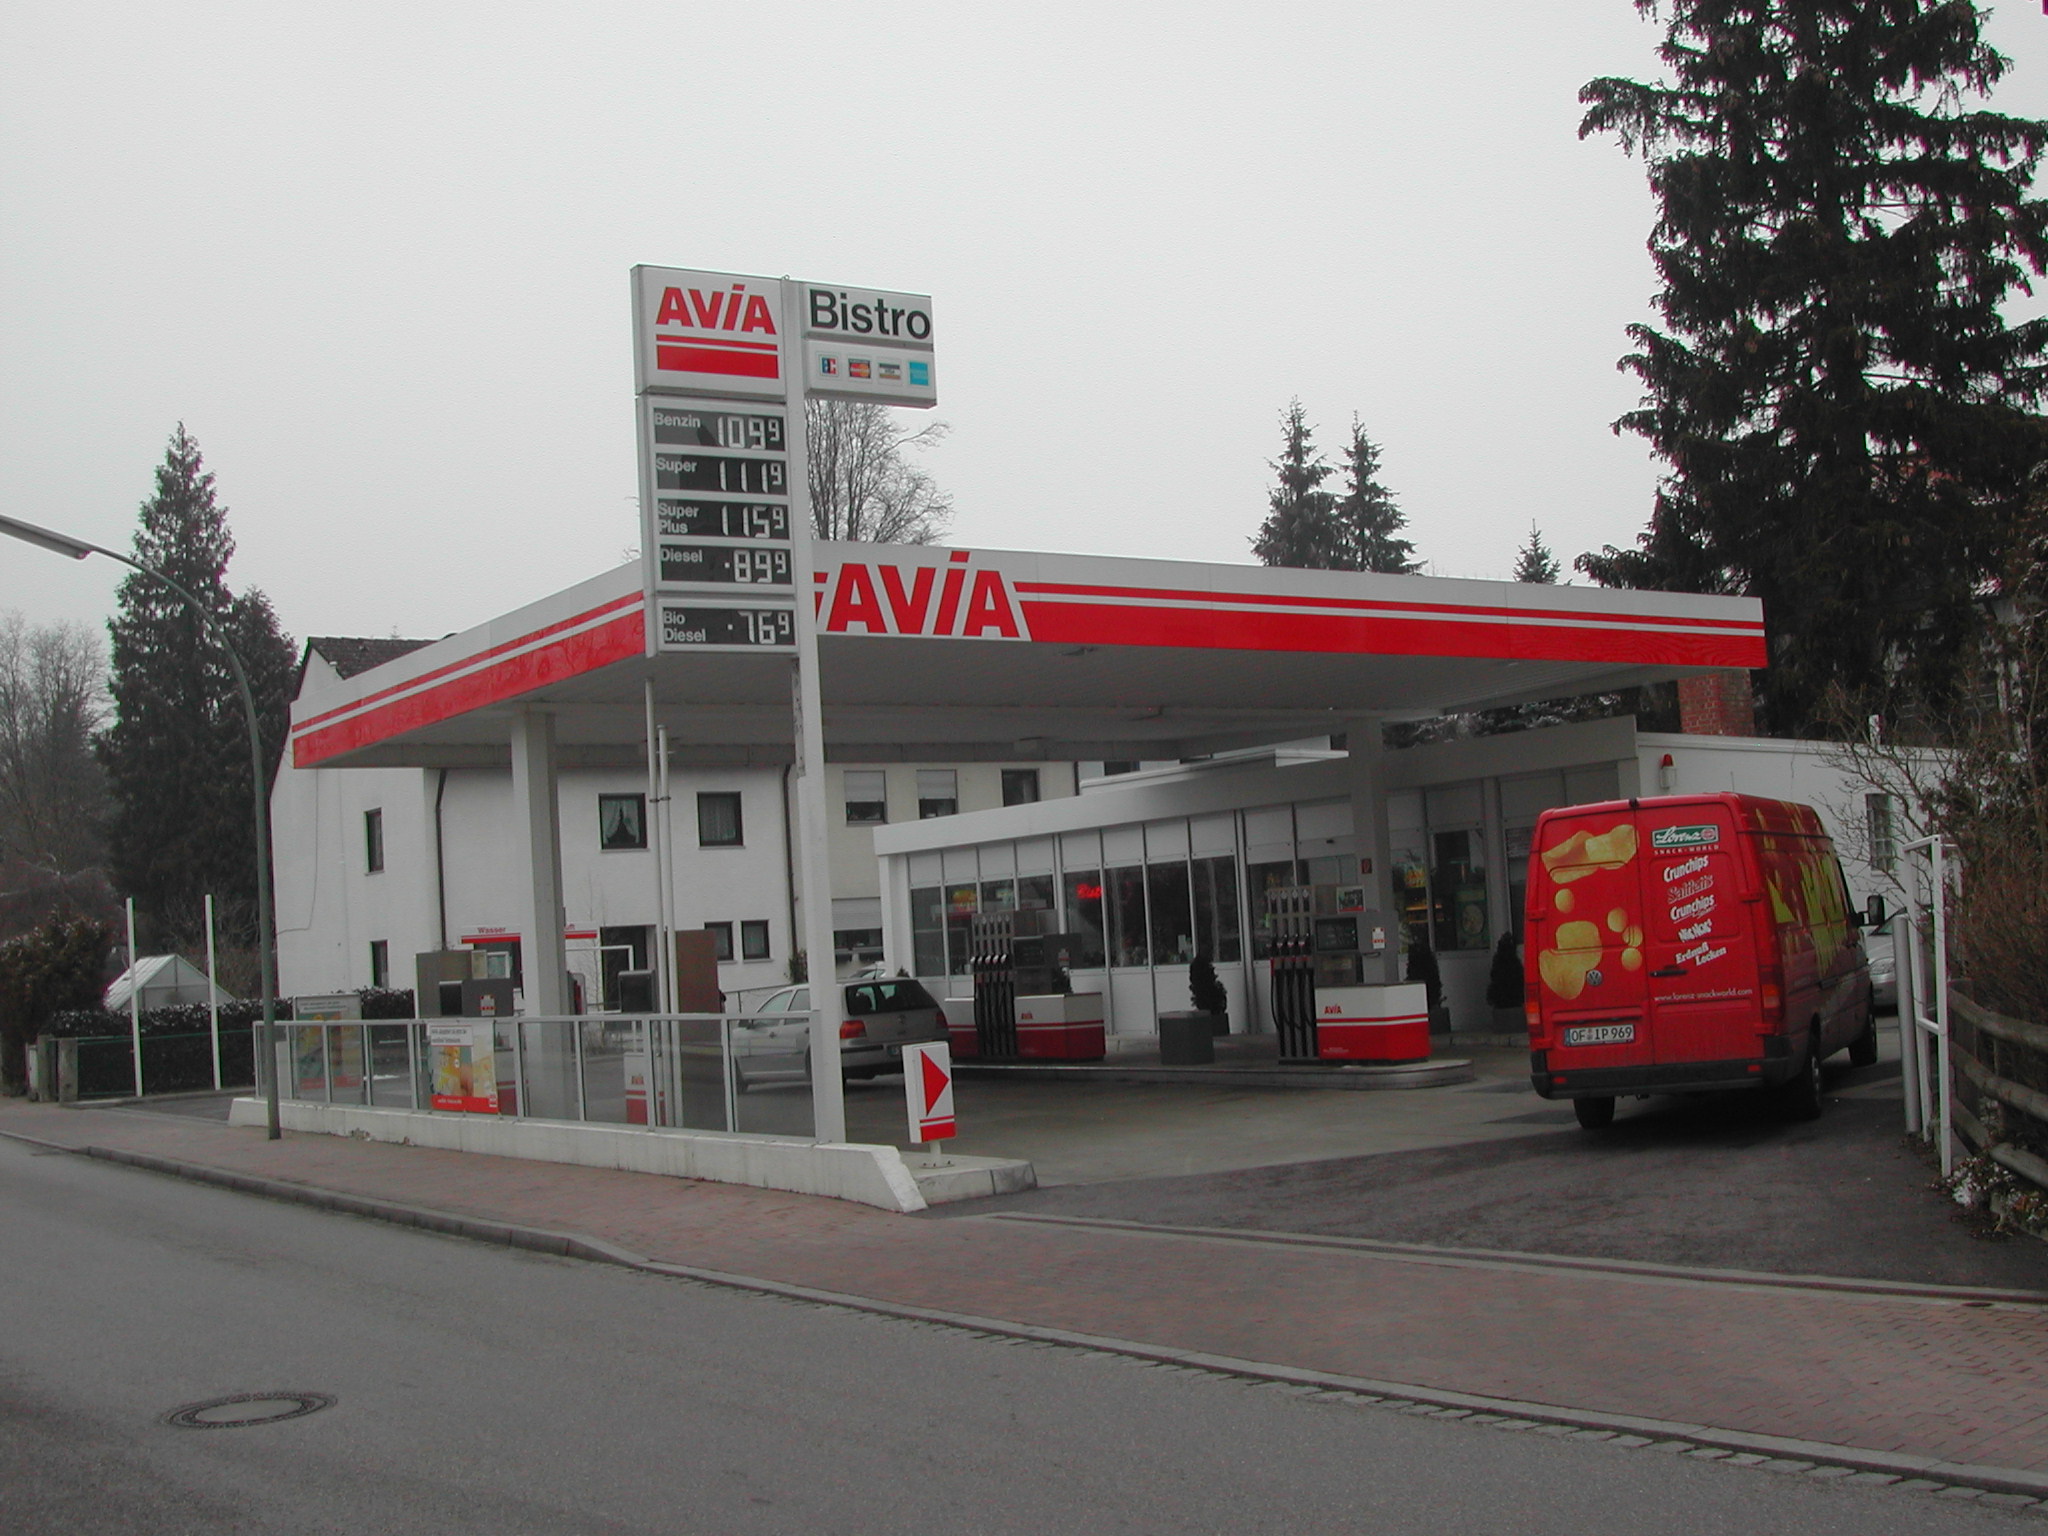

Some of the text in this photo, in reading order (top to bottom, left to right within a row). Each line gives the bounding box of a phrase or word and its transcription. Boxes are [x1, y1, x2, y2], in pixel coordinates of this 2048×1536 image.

[656, 284, 777, 335] AVIA
[810, 289, 931, 340] Bistro
[654, 412, 701, 428] Benzin
[656, 457, 698, 473] Super
[659, 502, 700, 519] Super
[660, 519, 689, 534] Plus
[660, 549, 703, 563] Diesel
[826, 551, 1020, 638] AVIA
[663, 611, 686, 625] Bio
[664, 627, 706, 643] Diesel
[1663, 855, 1709, 883] Crunchips
[1670, 894, 1715, 920] Crunchips
[1572, 1030, 1586, 1042] OF
[1611, 1026, 1632, 1039] 969
